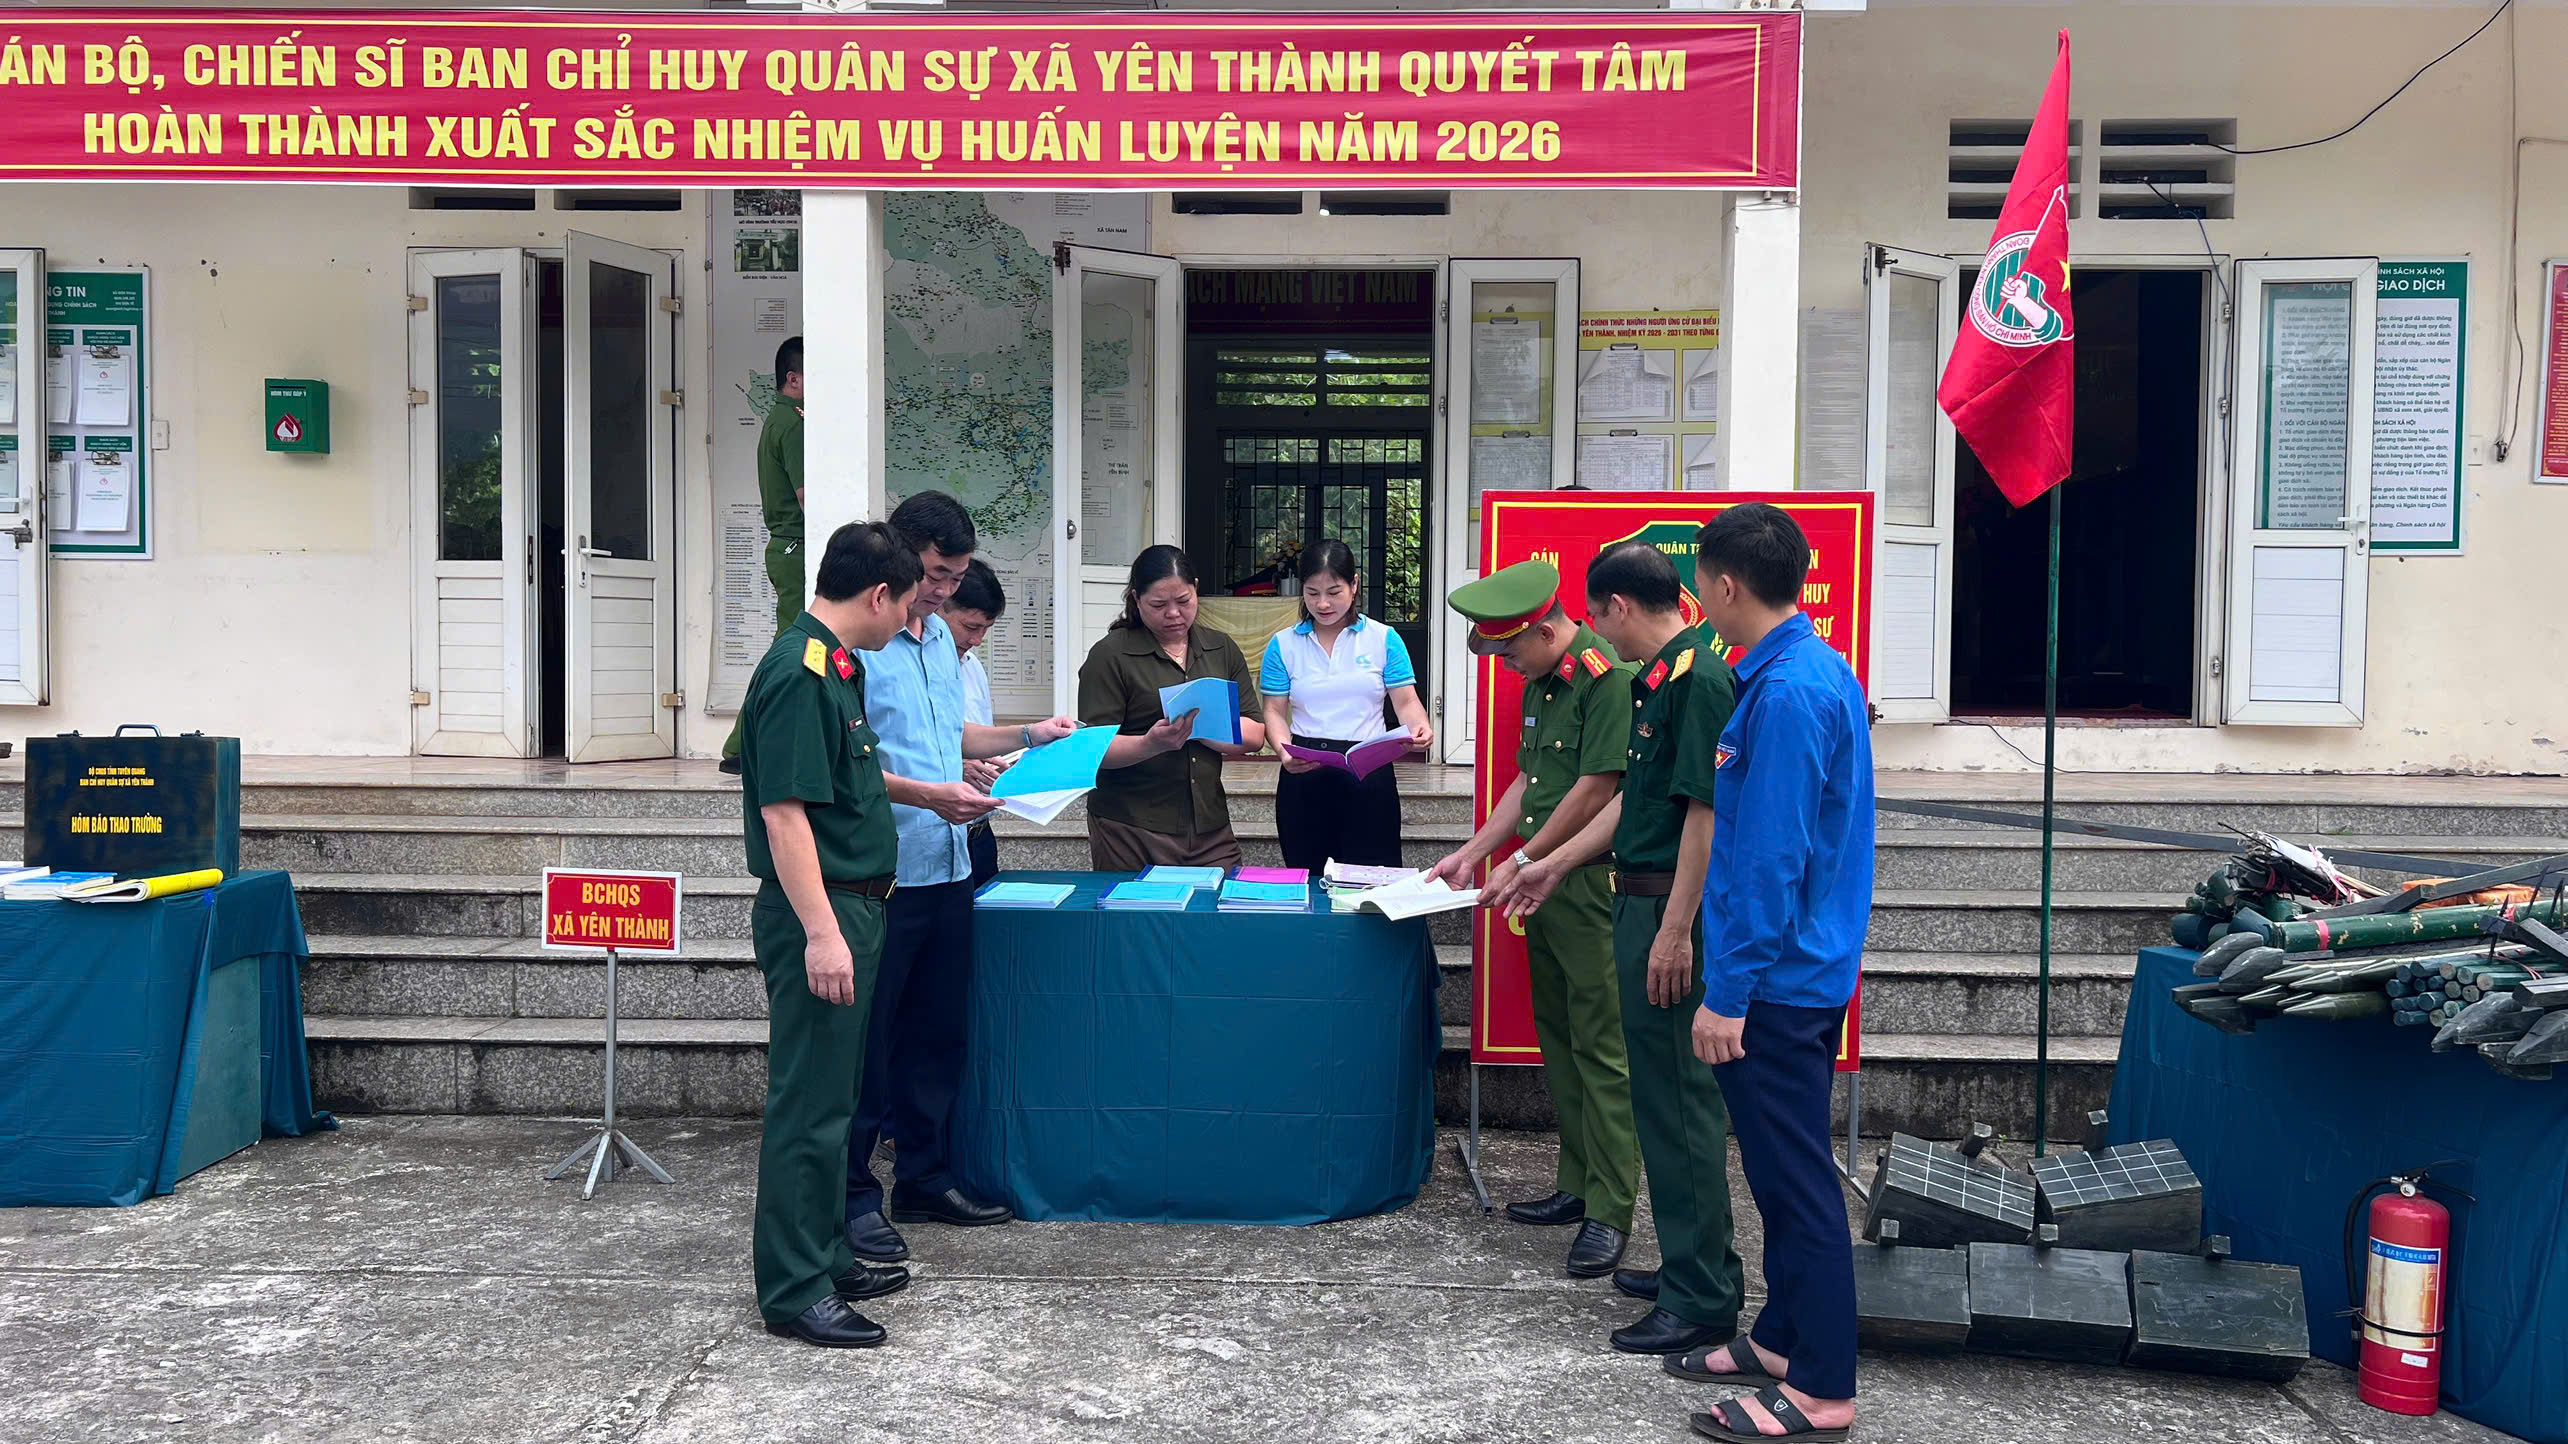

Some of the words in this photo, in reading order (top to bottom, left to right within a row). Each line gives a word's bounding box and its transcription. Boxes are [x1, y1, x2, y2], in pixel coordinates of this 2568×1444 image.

[84, 35, 165, 95] BỘ,
[183, 31, 336, 88] CHIẾN
[355, 38, 405, 88] SĨ
[423, 47, 527, 89] BAN
[547, 34, 631, 90] CHỈ
[650, 49, 746, 91] HUY
[766, 41, 905, 96] QUÂN
[924, 45, 998, 101] SỰ
[1009, 41, 1076, 92] XÃ
[1095, 42, 1193, 92] YÊN
[1212, 42, 1380, 92] THÀNH
[1399, 35, 1558, 97] QUYẾT
[1575, 41, 1686, 91] TÂM
[84, 105, 222, 154] HOÀN
[239, 106, 407, 157] THÀNH
[426, 103, 557, 158] XUẤT
[575, 105, 675, 160] SẮC
[694, 111, 860, 169] NHIỆM
[877, 119, 943, 170] VỤ
[961, 105, 1101, 161] HUẤN
[1120, 111, 1281, 171] LUYỆN
[1300, 111, 1418, 162] NĂM
[1437, 121, 1561, 161] 2026
[2393, 267, 2415, 275] SÁCH
[2417, 267, 2428, 275] XÃ
[2430, 267, 2445, 276] HỘI
[66, 286, 86, 297] TIN
[2377, 280, 2409, 291] GIAO
[2413, 278, 2445, 292] DỊCH
[2009, 332, 2032, 341] MINH
[1655, 541, 1687, 555] QUÂN
[1803, 583, 1831, 604] HUY
[1813, 615, 1835, 642] SỰ
[91, 813, 108, 833] BÁO
[109, 816, 130, 833] THAO
[131, 811, 162, 833] TRƯỜNG
[582, 882, 641, 907] BCHQS
[553, 910, 575, 936] XÃ
[579, 911, 611, 937] YÊN
[615, 913, 669, 940] THÀNH
